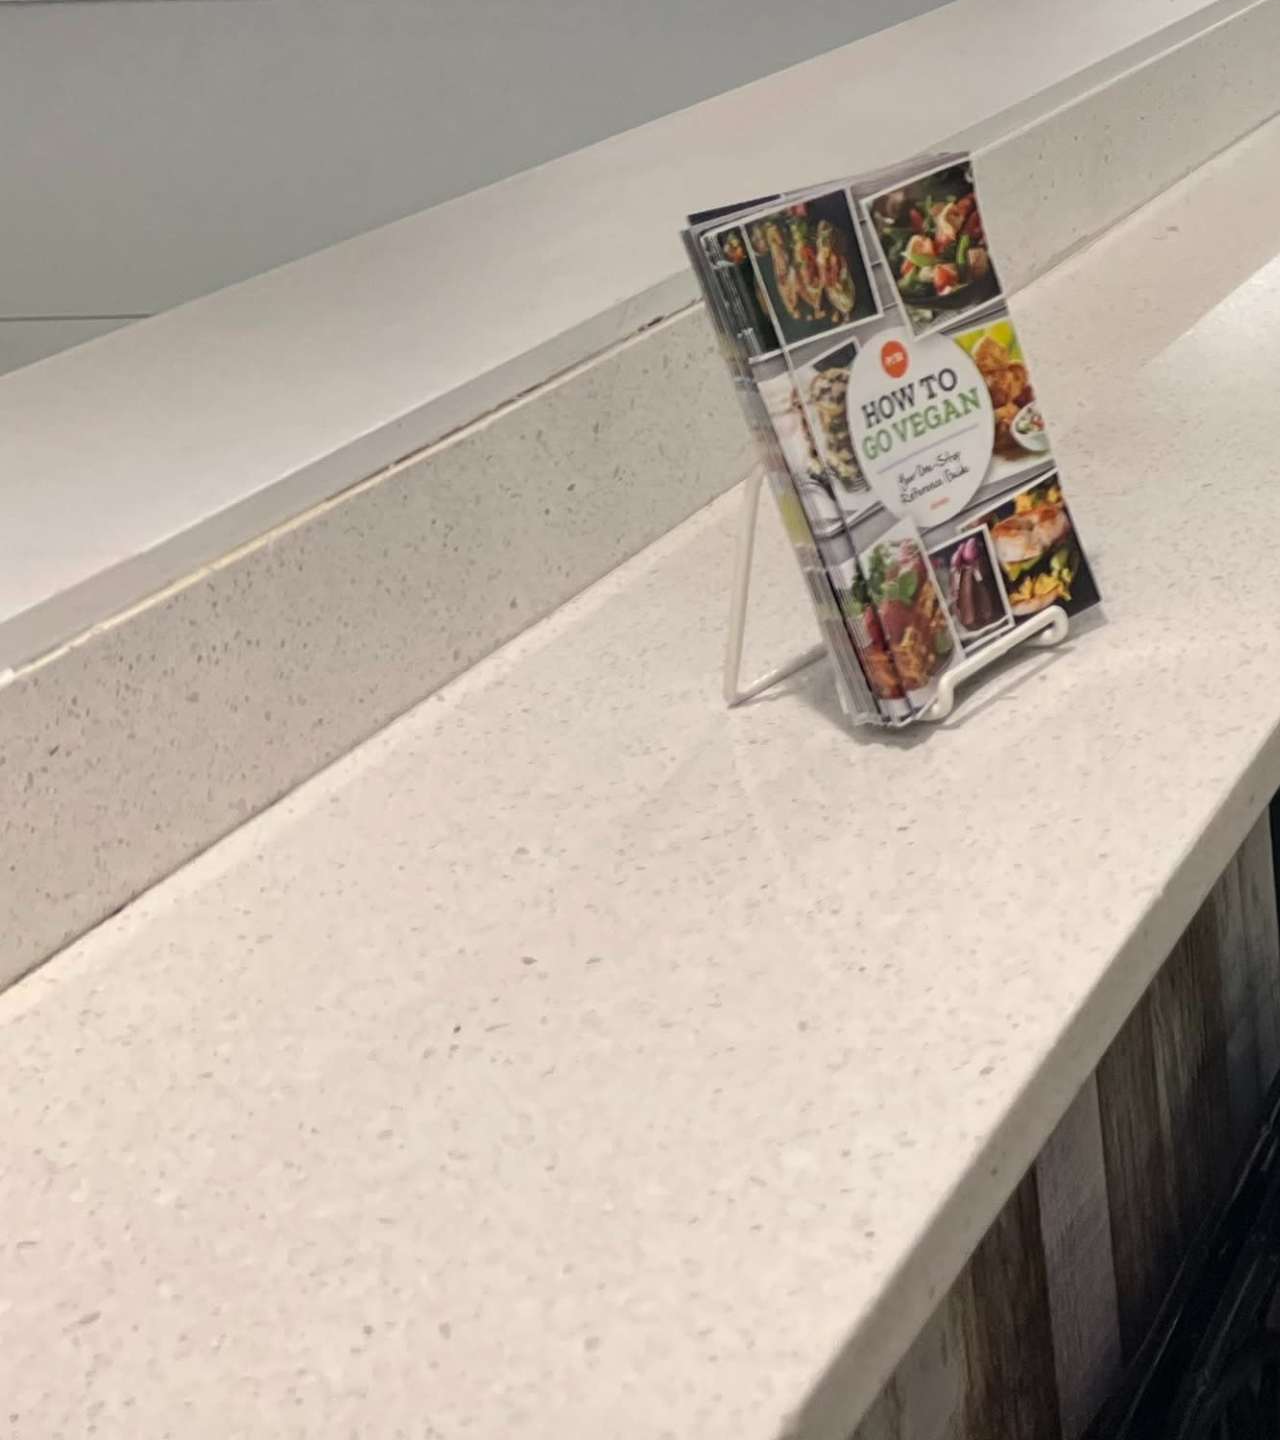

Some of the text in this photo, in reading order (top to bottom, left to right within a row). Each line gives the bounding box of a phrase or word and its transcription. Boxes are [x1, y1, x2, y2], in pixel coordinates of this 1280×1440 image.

[861, 368, 957, 429] HOW TO
[862, 387, 981, 460] GO VEGAN
